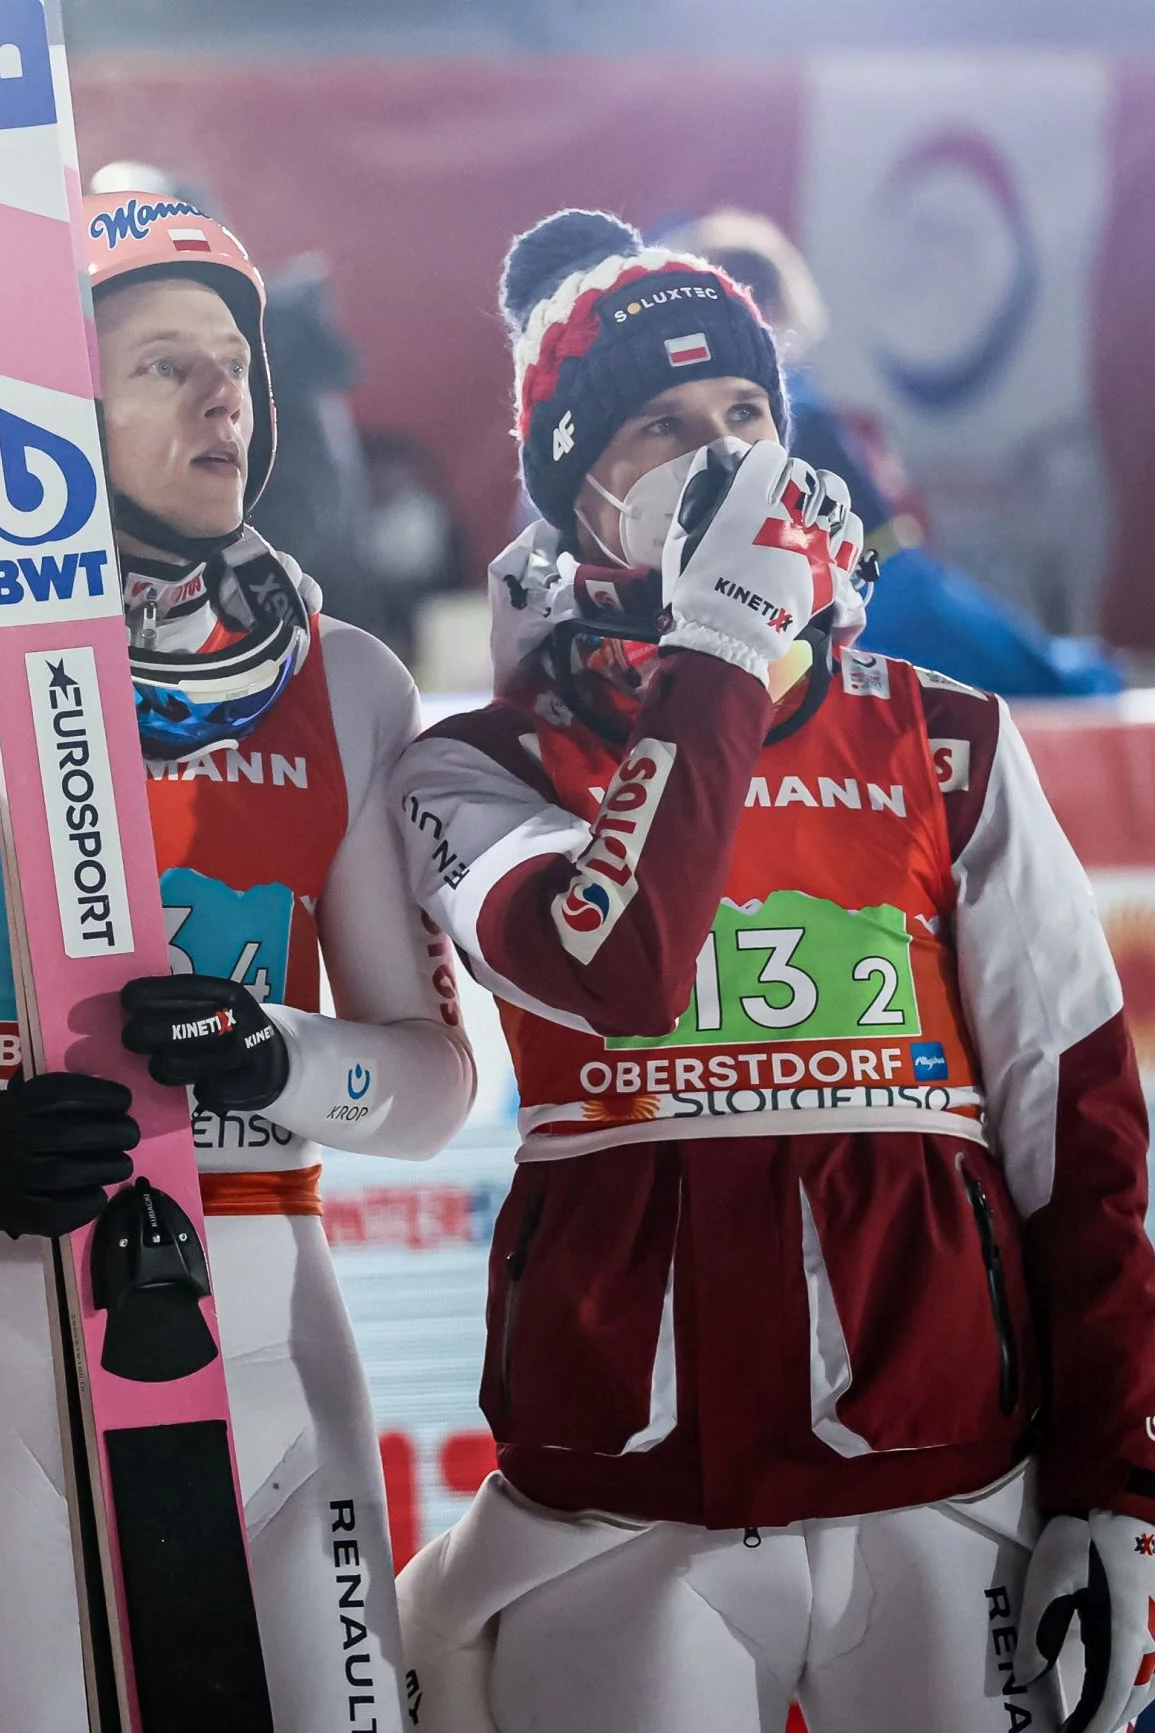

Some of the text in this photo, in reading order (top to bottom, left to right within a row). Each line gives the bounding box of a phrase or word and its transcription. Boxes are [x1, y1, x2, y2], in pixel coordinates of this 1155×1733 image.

[552, 410, 576, 462] 4F
[49, 686, 116, 948] EUROSPORT
[586, 756, 658, 886] LOTOS
[696, 926, 906, 1033] 13 2
[580, 1048, 901, 1094] OBERSTDORF
[326, 1105, 369, 1122] KROP
